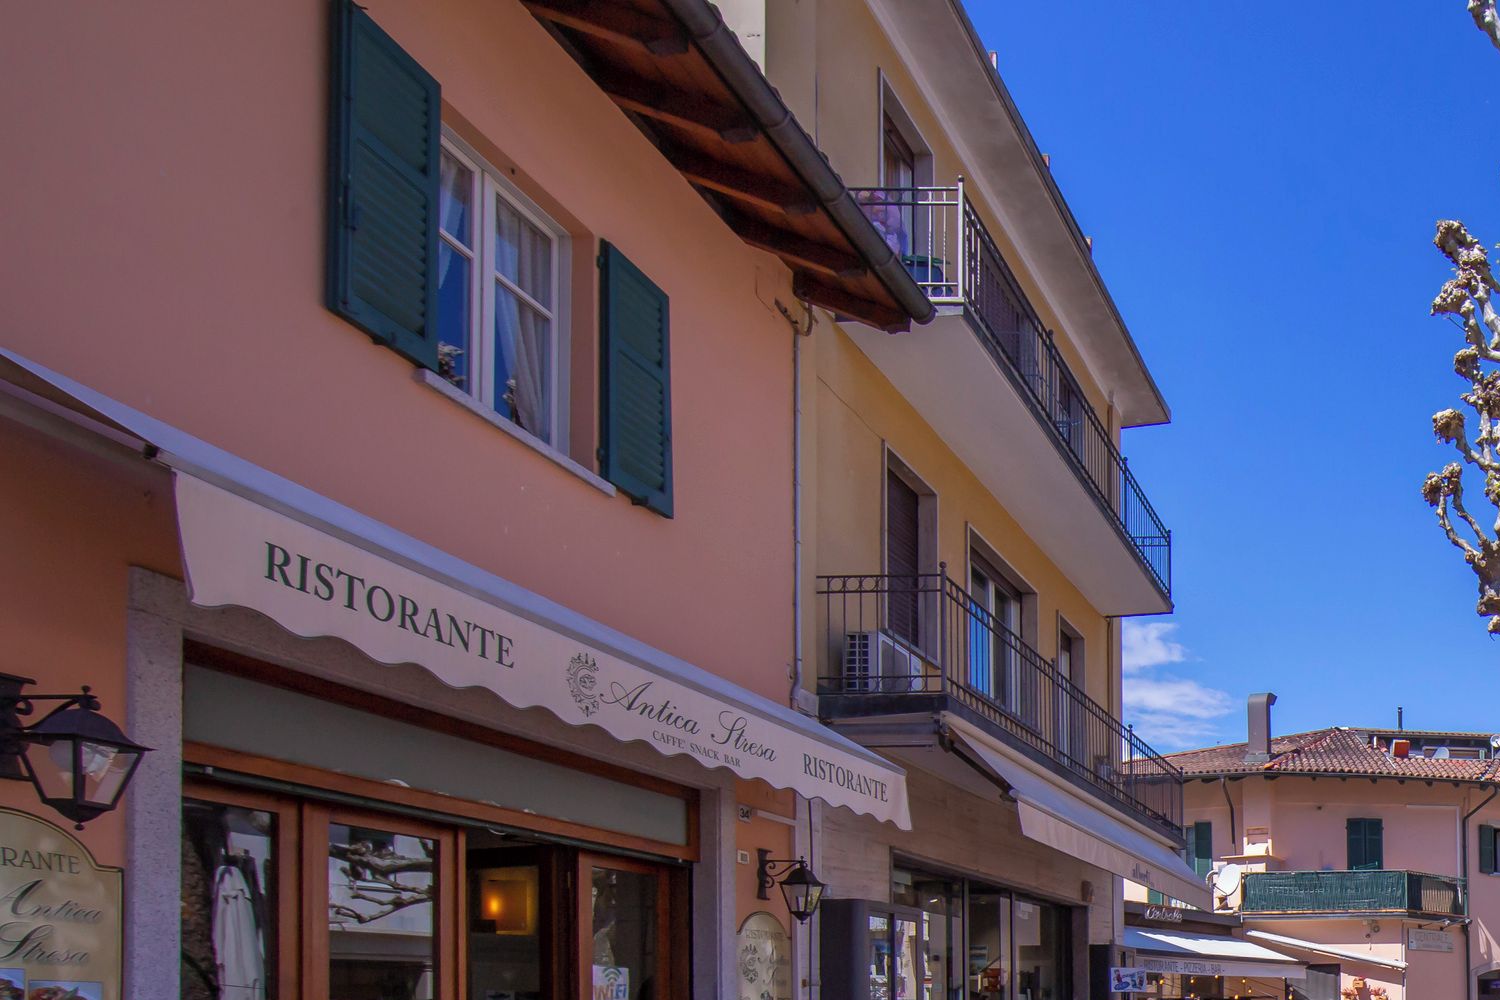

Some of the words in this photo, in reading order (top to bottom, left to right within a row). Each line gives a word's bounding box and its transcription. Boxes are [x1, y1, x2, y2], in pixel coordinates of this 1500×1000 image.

[264, 541, 515, 669] RISTORANTE
[600, 681, 699, 735] Antica
[711, 711, 777, 762] Stresa
[653, 730, 685, 750] CAFFE'
[690, 744, 719, 761] SNACK
[724, 755, 741, 768] BAR
[803, 753, 888, 802] RISTORANTE
[740, 807, 750, 819] 34
[1144, 959, 1179, 973] RISTORANTE
[1184, 961, 1207, 974] PIZZERIA
